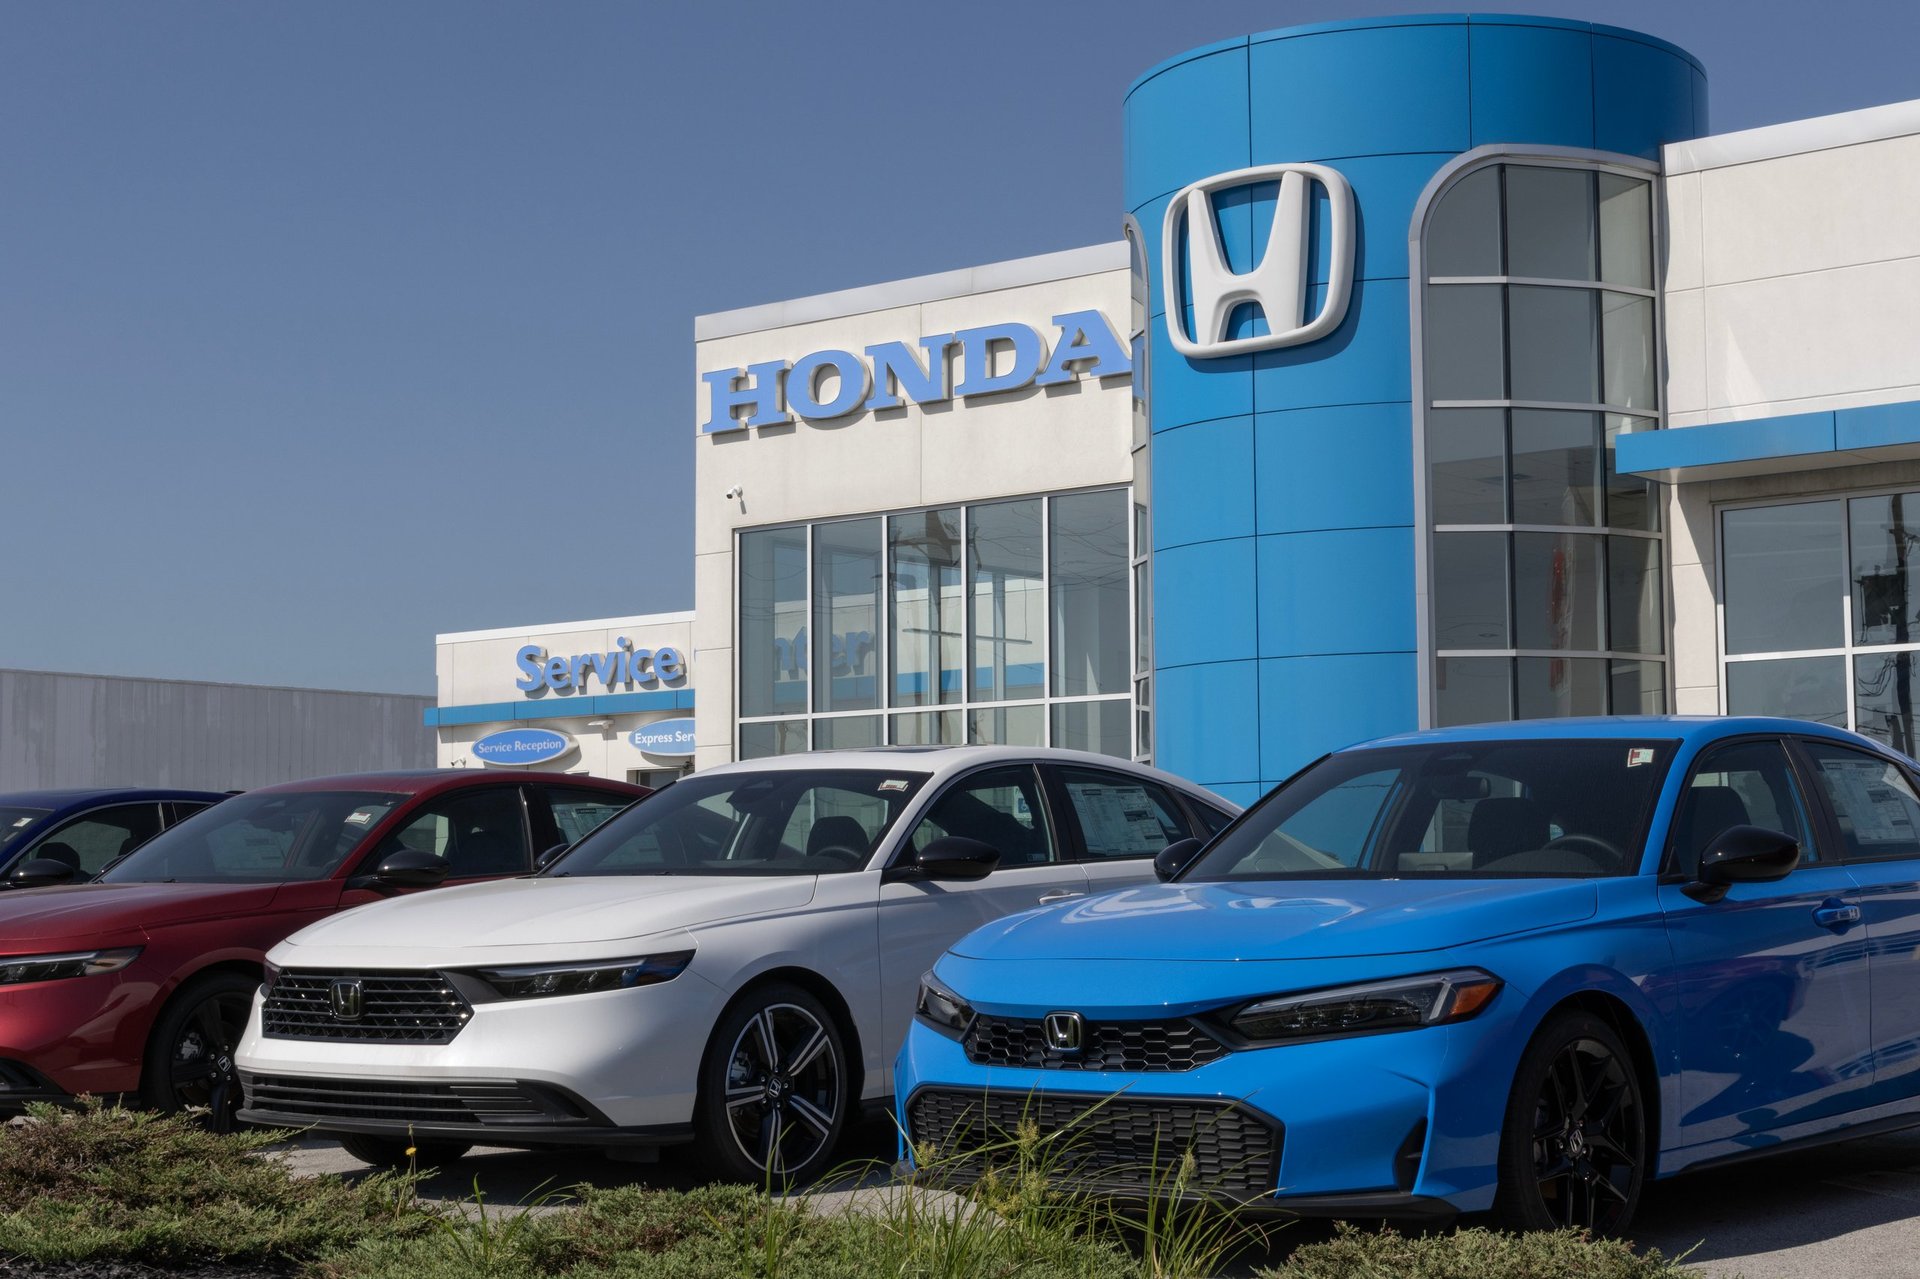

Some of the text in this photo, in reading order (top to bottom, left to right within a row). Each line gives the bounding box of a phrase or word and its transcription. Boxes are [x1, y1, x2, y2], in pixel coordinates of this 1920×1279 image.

[702, 309, 1132, 434] HONDA
[516, 636, 682, 692] Service
[478, 739, 562, 754] Service Reception
[634, 732, 674, 747] Express
